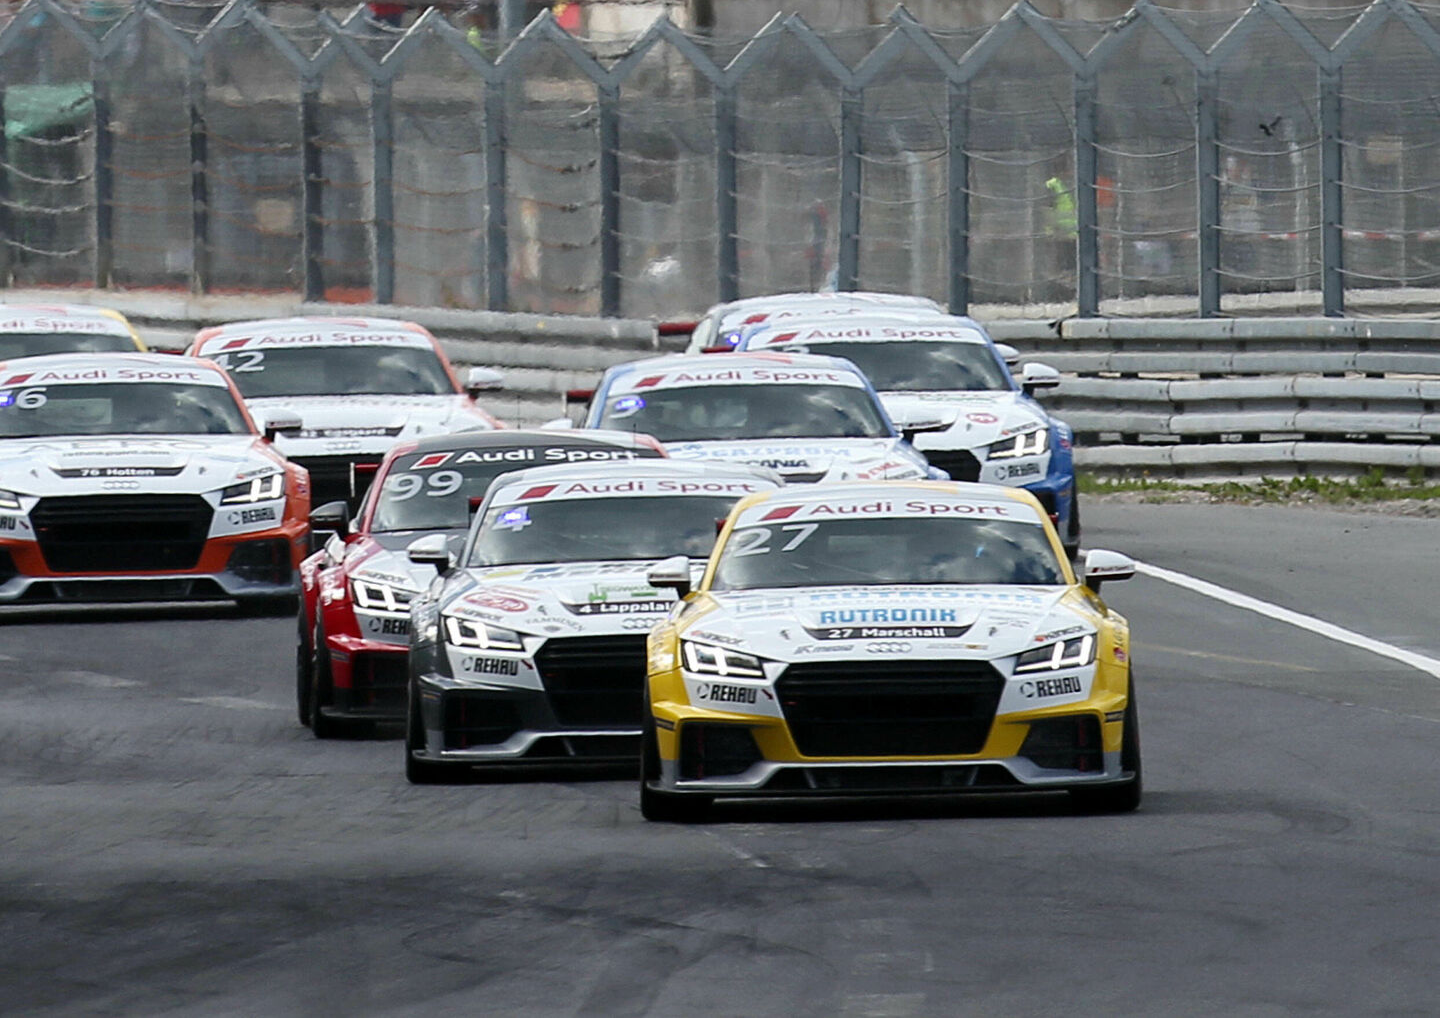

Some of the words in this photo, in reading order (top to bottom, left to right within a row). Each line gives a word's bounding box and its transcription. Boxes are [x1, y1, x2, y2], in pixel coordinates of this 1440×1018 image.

[258, 334, 322, 344] Audi
[332, 333, 409, 346] Sport
[805, 329, 871, 339] Audi
[881, 328, 961, 340] Sport
[214, 351, 265, 373] 42
[40, 370, 107, 381] Audi
[124, 369, 202, 383] Sport
[674, 371, 742, 382] Audi
[752, 369, 840, 383] Sport
[456, 448, 536, 464] Audi
[544, 447, 639, 463] Sport
[386, 469, 464, 502] 99
[564, 481, 645, 495] Audi
[656, 480, 758, 495] Sport
[810, 502, 892, 515] Audi
[905, 501, 1009, 516] Sport
[734, 523, 820, 558] 27
[579, 605, 593, 613] 4
[600, 602, 676, 613] Lappalai
[820, 608, 956, 624] RUTRONIK
[382, 619, 410, 635] REH
[828, 628, 852, 639] 27
[861, 627, 946, 638] Marschall
[473, 657, 519, 676] REHAU
[711, 684, 758, 704] REHAU
[1036, 676, 1082, 698] REHAU
